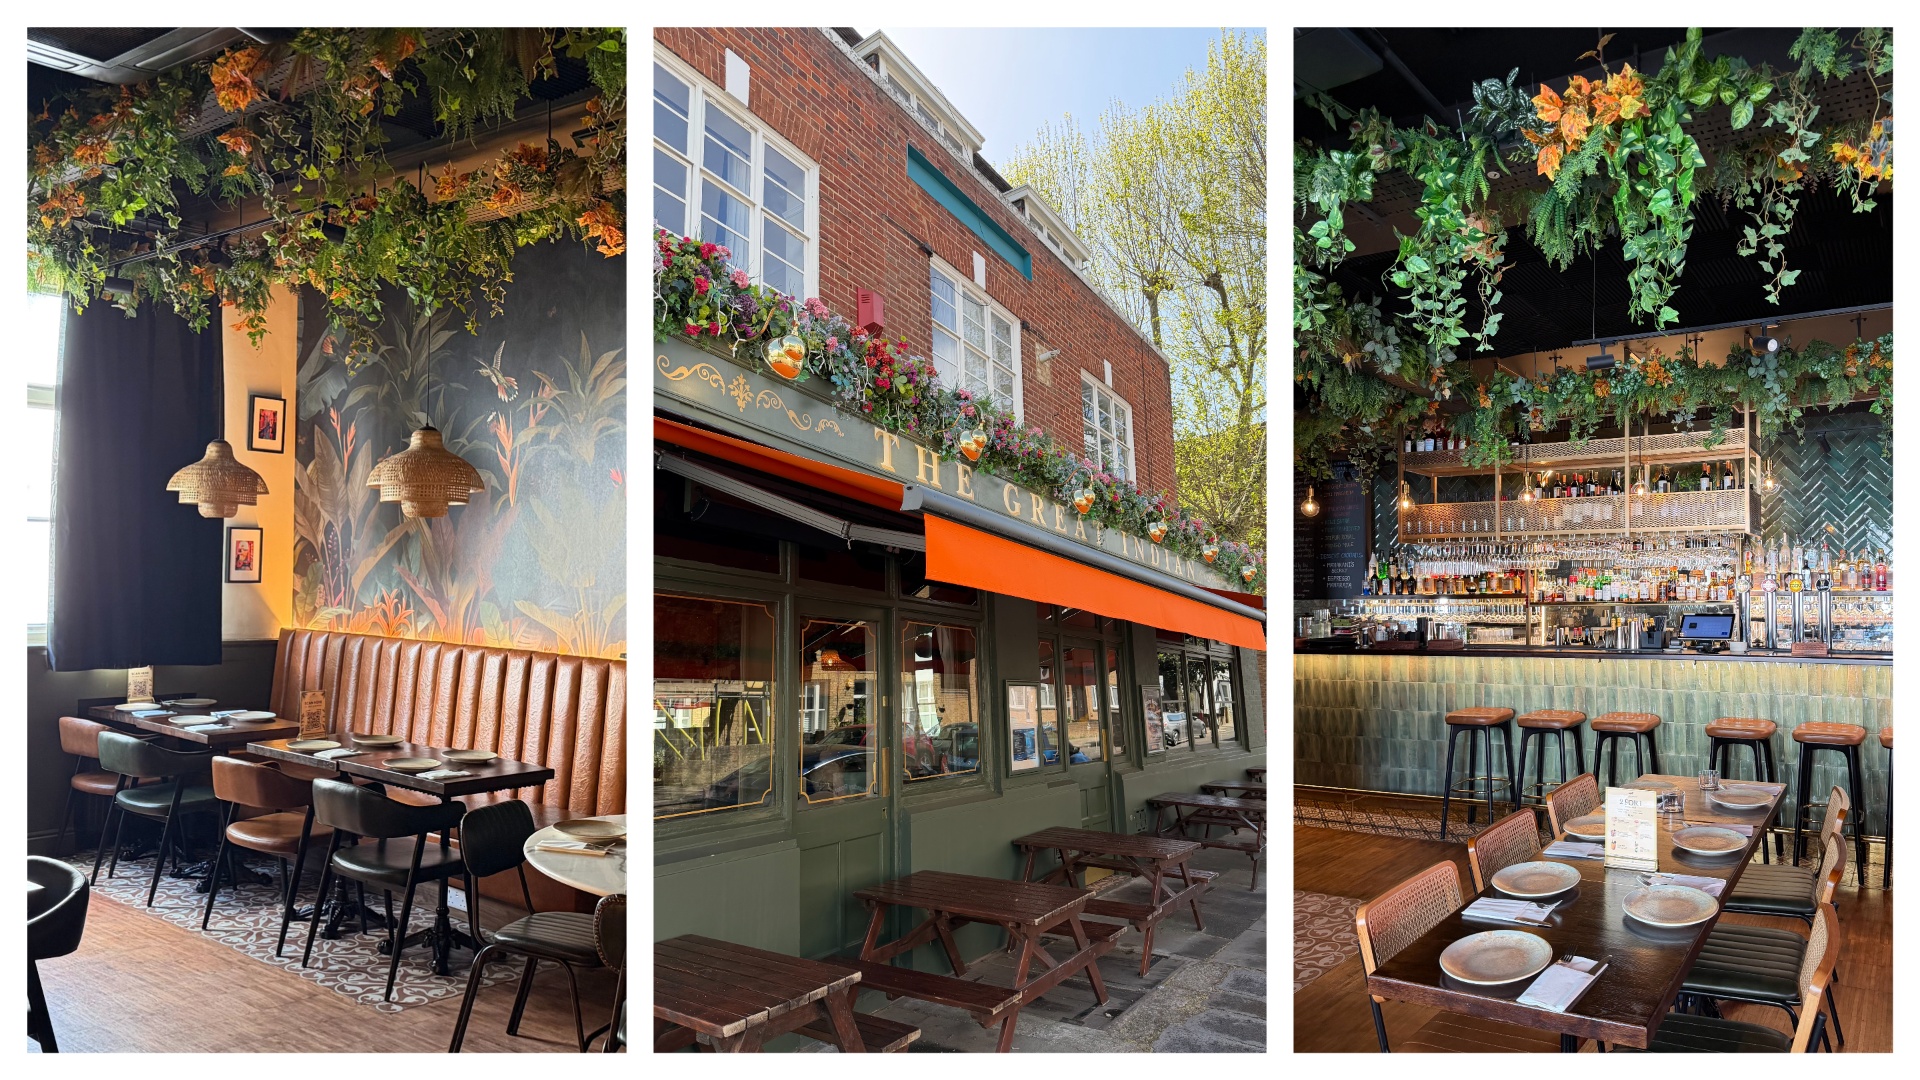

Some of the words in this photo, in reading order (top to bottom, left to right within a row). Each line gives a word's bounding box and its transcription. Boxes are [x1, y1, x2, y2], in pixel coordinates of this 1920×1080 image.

[874, 427, 975, 501] THE
[1003, 482, 1105, 546] GREAT
[1120, 530, 1196, 580] INDIAN
